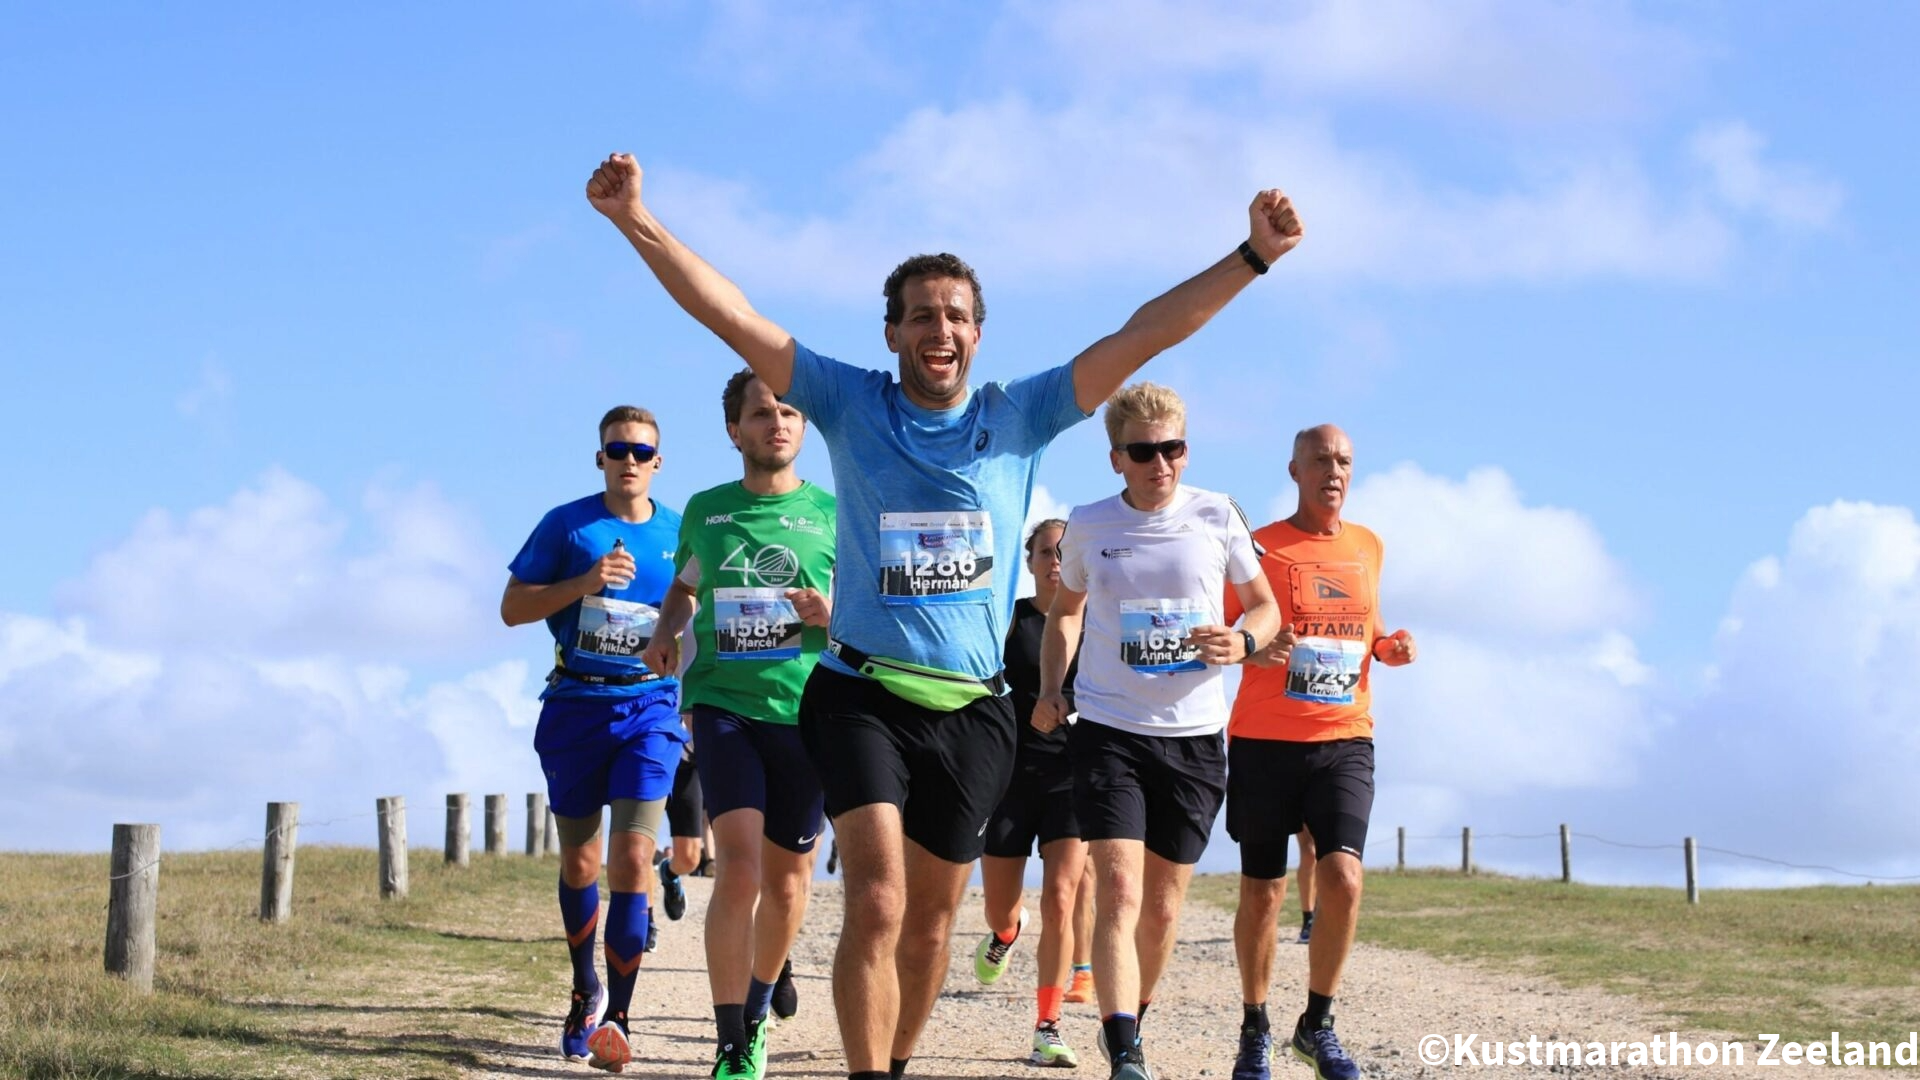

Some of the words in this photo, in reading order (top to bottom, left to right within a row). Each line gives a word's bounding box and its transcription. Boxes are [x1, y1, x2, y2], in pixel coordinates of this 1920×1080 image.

[705, 514, 732, 525] HOKA
[900, 550, 976, 577] 1286
[910, 576, 970, 590] Herman
[727, 617, 787, 637] 1584
[595, 624, 640, 647] 446
[737, 636, 777, 648] Marcel
[1136, 628, 1195, 651] 163
[600, 641, 632, 655] Niklas
[1140, 650, 1172, 661] Anne
[1303, 663, 1351, 685] 1724
[1309, 683, 1339, 697] Gerwin
